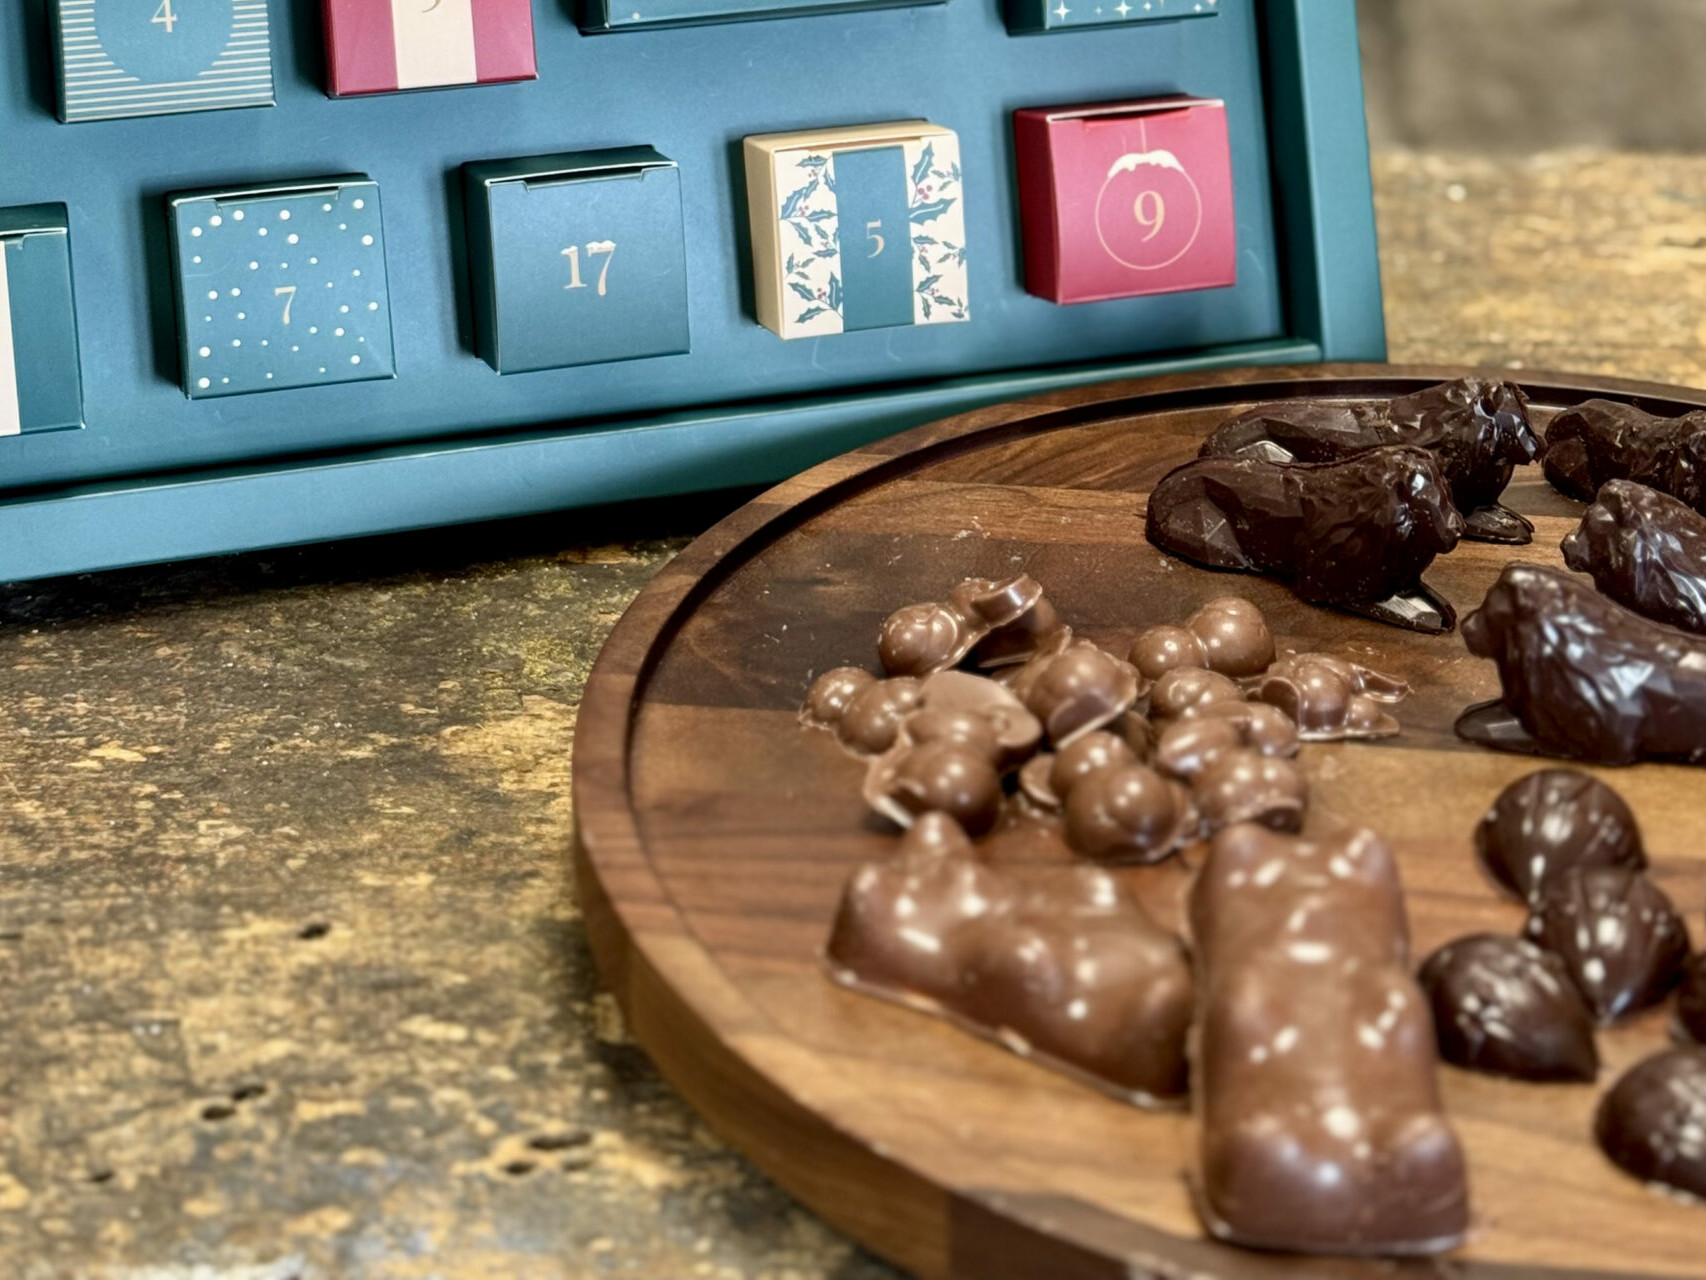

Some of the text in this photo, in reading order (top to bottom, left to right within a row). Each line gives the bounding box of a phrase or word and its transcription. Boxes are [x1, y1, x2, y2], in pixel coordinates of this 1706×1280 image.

[866, 219, 885, 258] 5
[1133, 190, 1165, 243] 9
[561, 239, 617, 296] 17
[274, 285, 297, 325] 7
